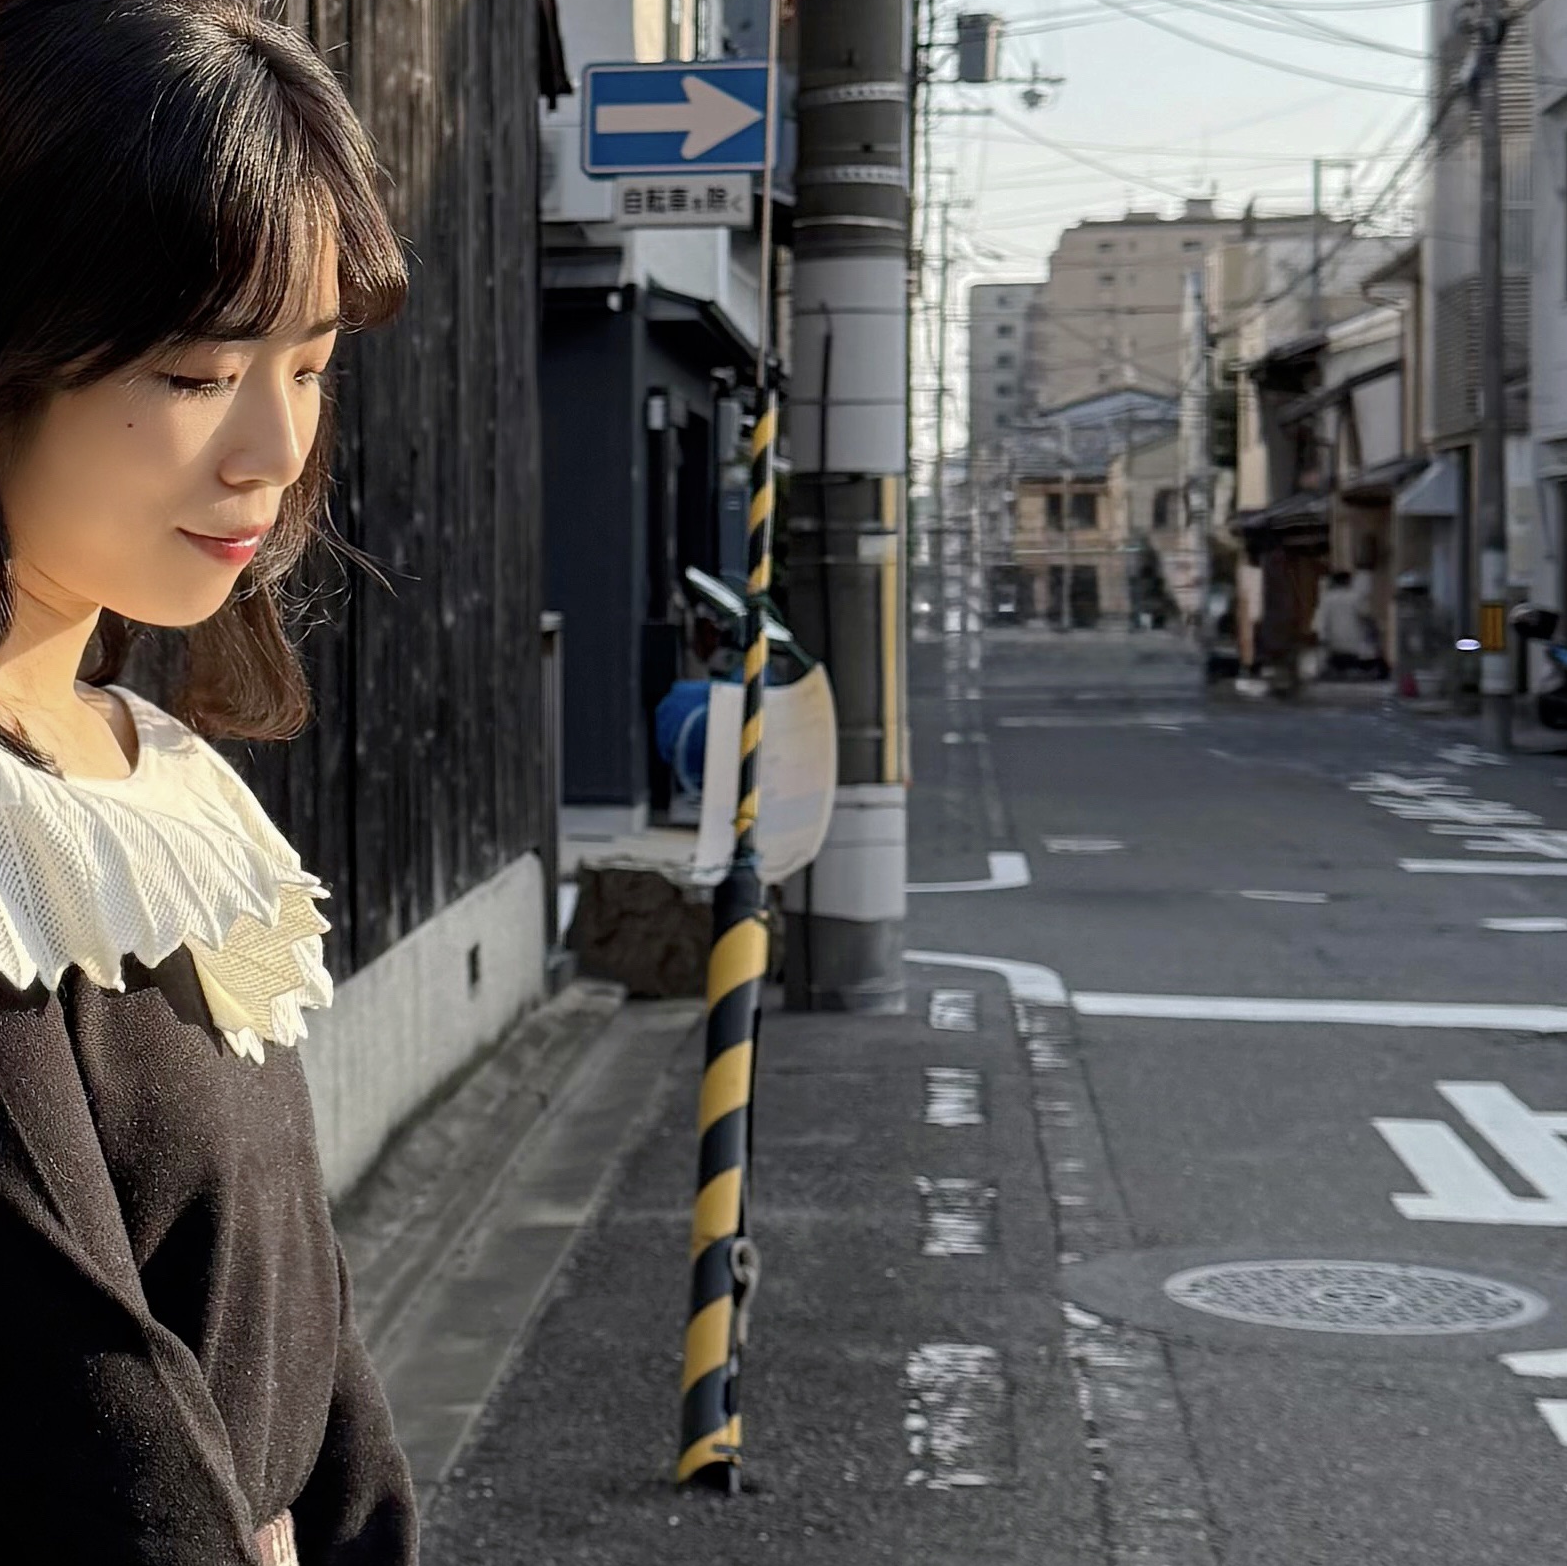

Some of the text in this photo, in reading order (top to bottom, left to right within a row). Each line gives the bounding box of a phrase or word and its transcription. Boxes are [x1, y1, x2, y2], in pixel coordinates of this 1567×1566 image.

[624, 185, 745, 214] 自転車を除く
